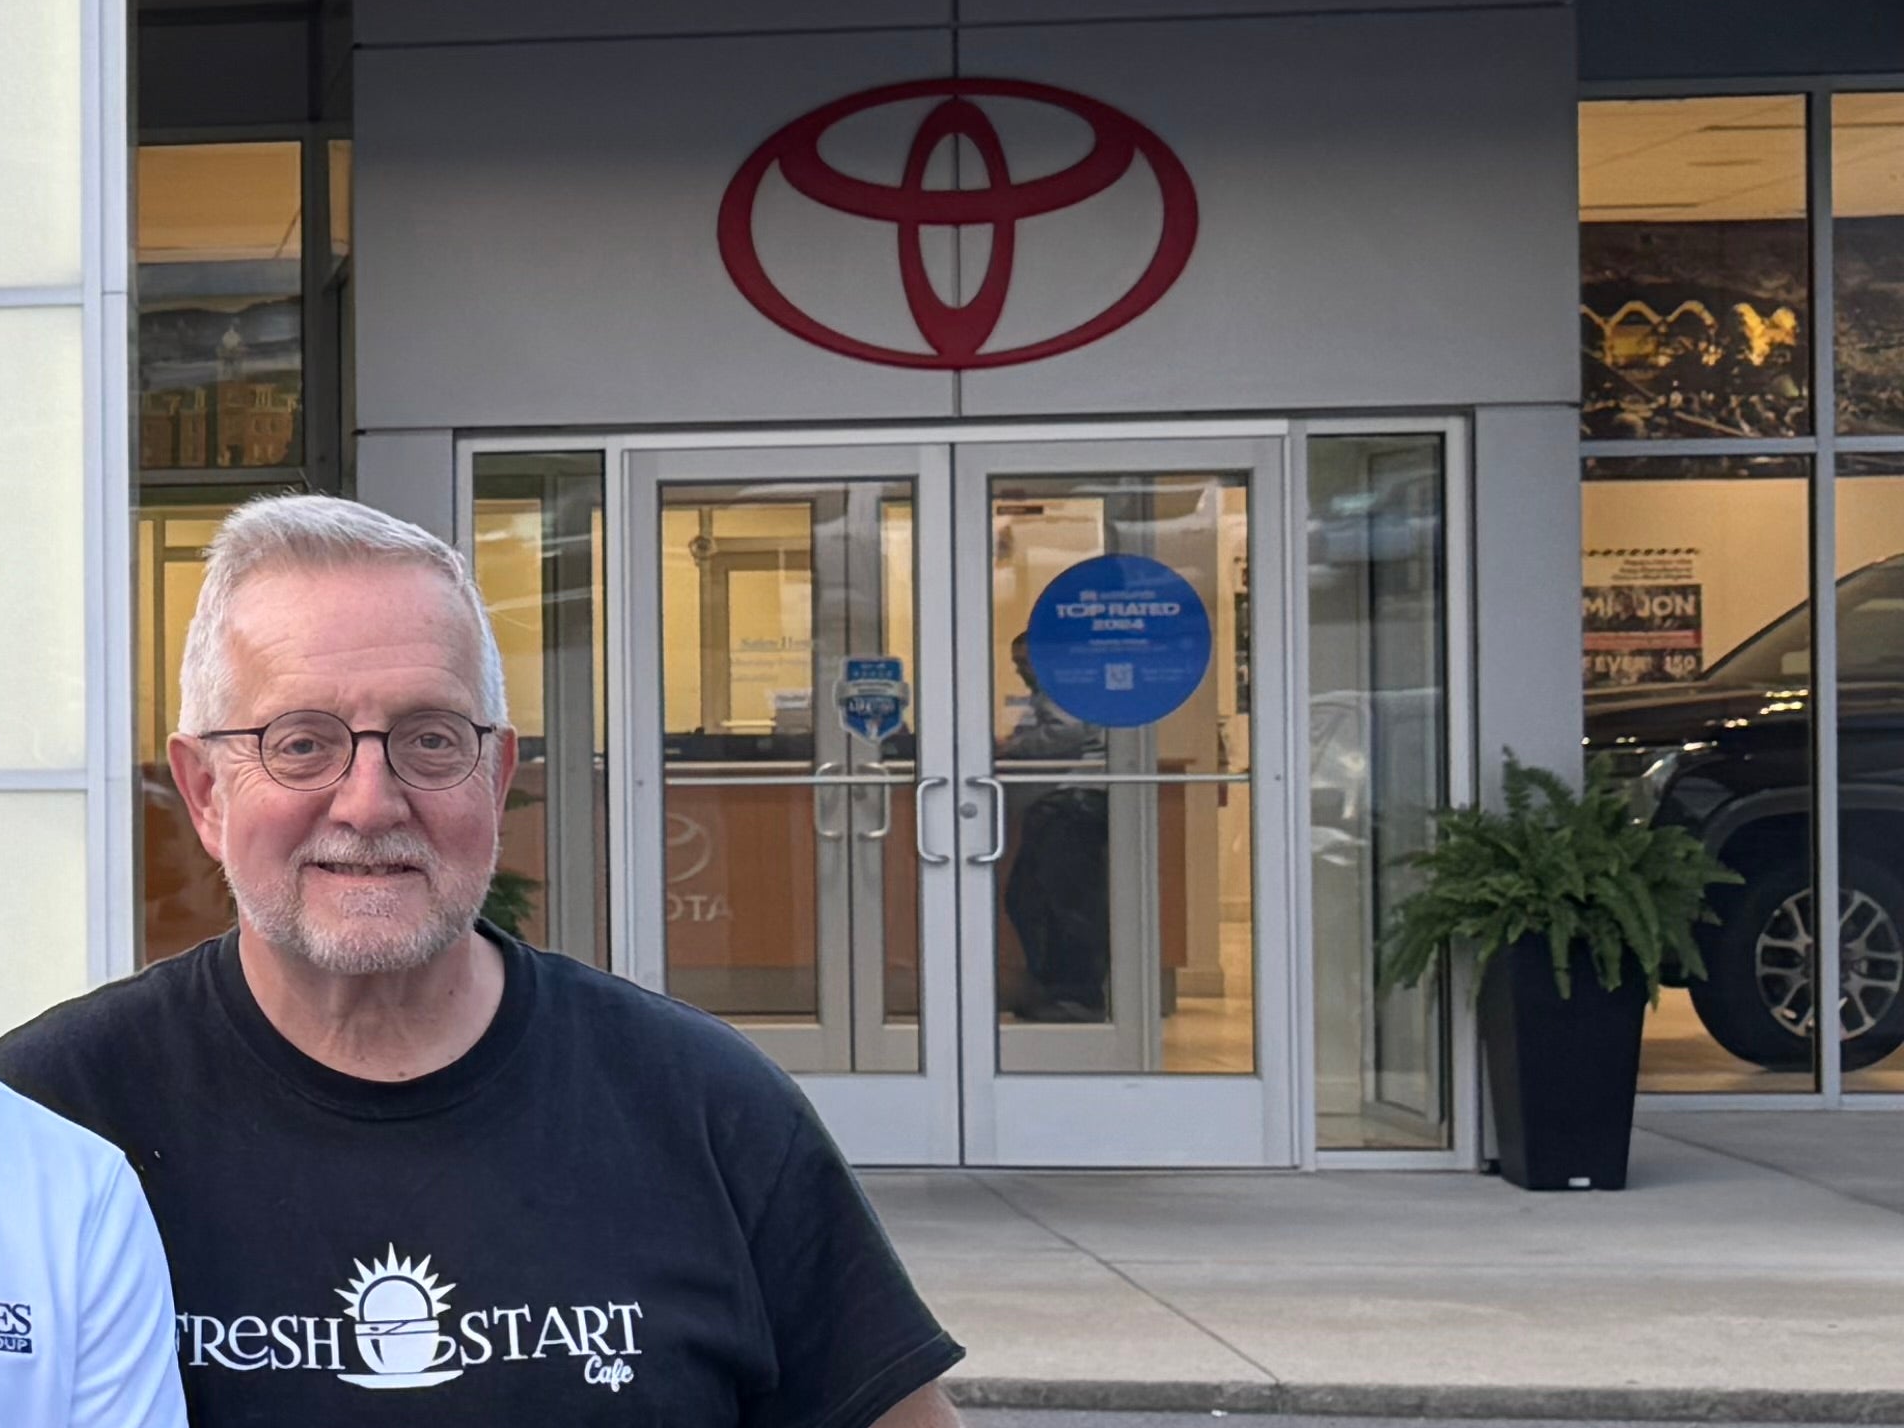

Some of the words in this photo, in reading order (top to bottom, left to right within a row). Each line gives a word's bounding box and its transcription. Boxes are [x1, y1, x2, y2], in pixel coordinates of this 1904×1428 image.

[1056, 603, 1105, 618] TOP
[1108, 602, 1181, 617] RATED
[459, 1301, 644, 1367] START
[584, 1355, 634, 1393] Cafe
